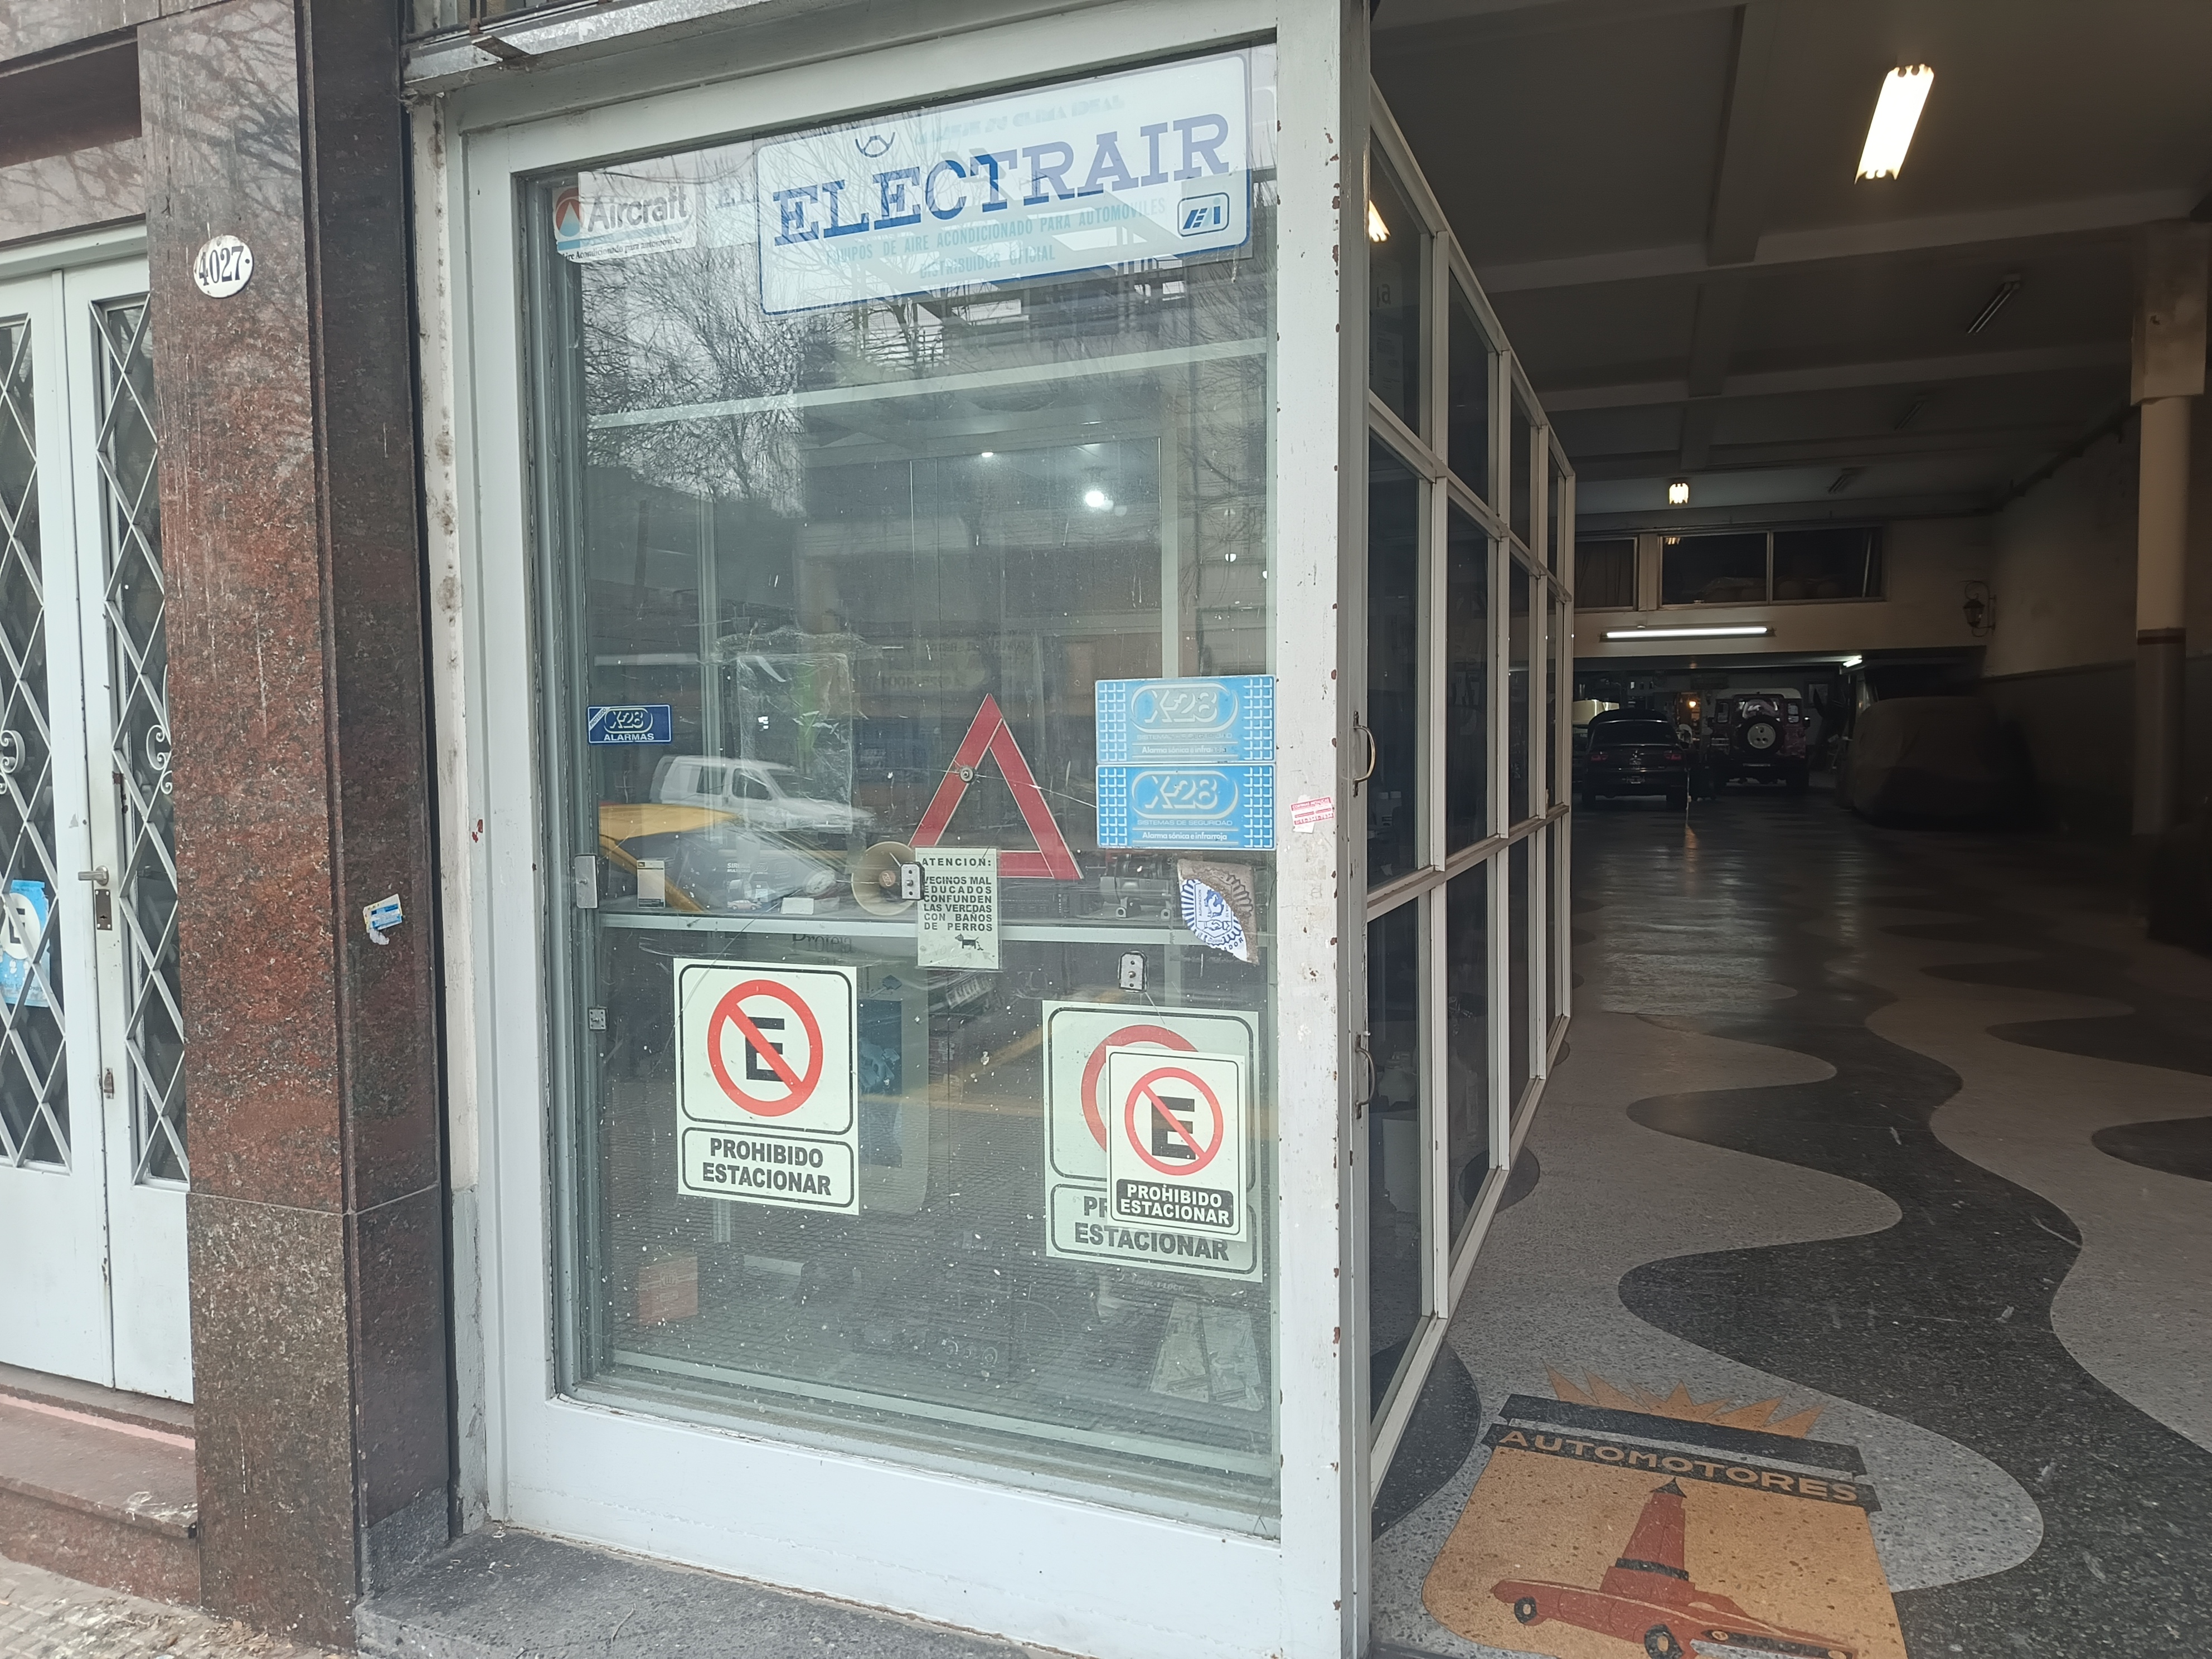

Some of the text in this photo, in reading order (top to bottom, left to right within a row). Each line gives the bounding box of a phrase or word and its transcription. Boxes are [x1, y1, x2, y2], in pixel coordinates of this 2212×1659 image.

[1071, 94, 1126, 117] IDEAL
[773, 113, 1229, 246] ELECTRAIR
[587, 185, 688, 232] Aircraft
[883, 240, 898, 256] DE
[904, 234, 929, 253] AIRE
[937, 219, 1033, 247] ACONDICIONADO
[1040, 215, 1071, 233] PARA
[1079, 197, 1166, 227] AUTOMOVILES
[576, 245, 623, 259] Acondicionado
[624, 244, 639, 254] para
[641, 236, 682, 249] automoviles
[199, 246, 244, 286] 4027
[920, 244, 1056, 279] DISTRIBUIDOR OFICIAL
[590, 708, 607, 727] PROTEGIDO
[604, 733, 654, 741] ALARMAS
[1168, 831, 1190, 840] sónica
[1195, 831, 1228, 842] infrarroja
[921, 857, 992, 867] ATENCION:
[924, 876, 992, 885] VECINOS MAL
[924, 885, 992, 894] EDUCADOS
[923, 895, 992, 904] CONFUNDEN
[945, 904, 992, 913] VEREDAS
[924, 912, 992, 923] CON BAÑOS
[924, 922, 993, 932] DE PERROS
[745, 1016, 785, 1082] E
[1151, 1095, 1196, 1160] E
[710, 1137, 823, 1168] PROHIBIDO
[702, 1162, 831, 1196] ESTACIONAR
[1127, 1183, 1223, 1207] PROHIBIDO
[1120, 1198, 1230, 1225] ESTACIONAR
[1075, 1221, 1230, 1261] ESTACIONAR
[1498, 1430, 1859, 1502] AUTOMOTORES
